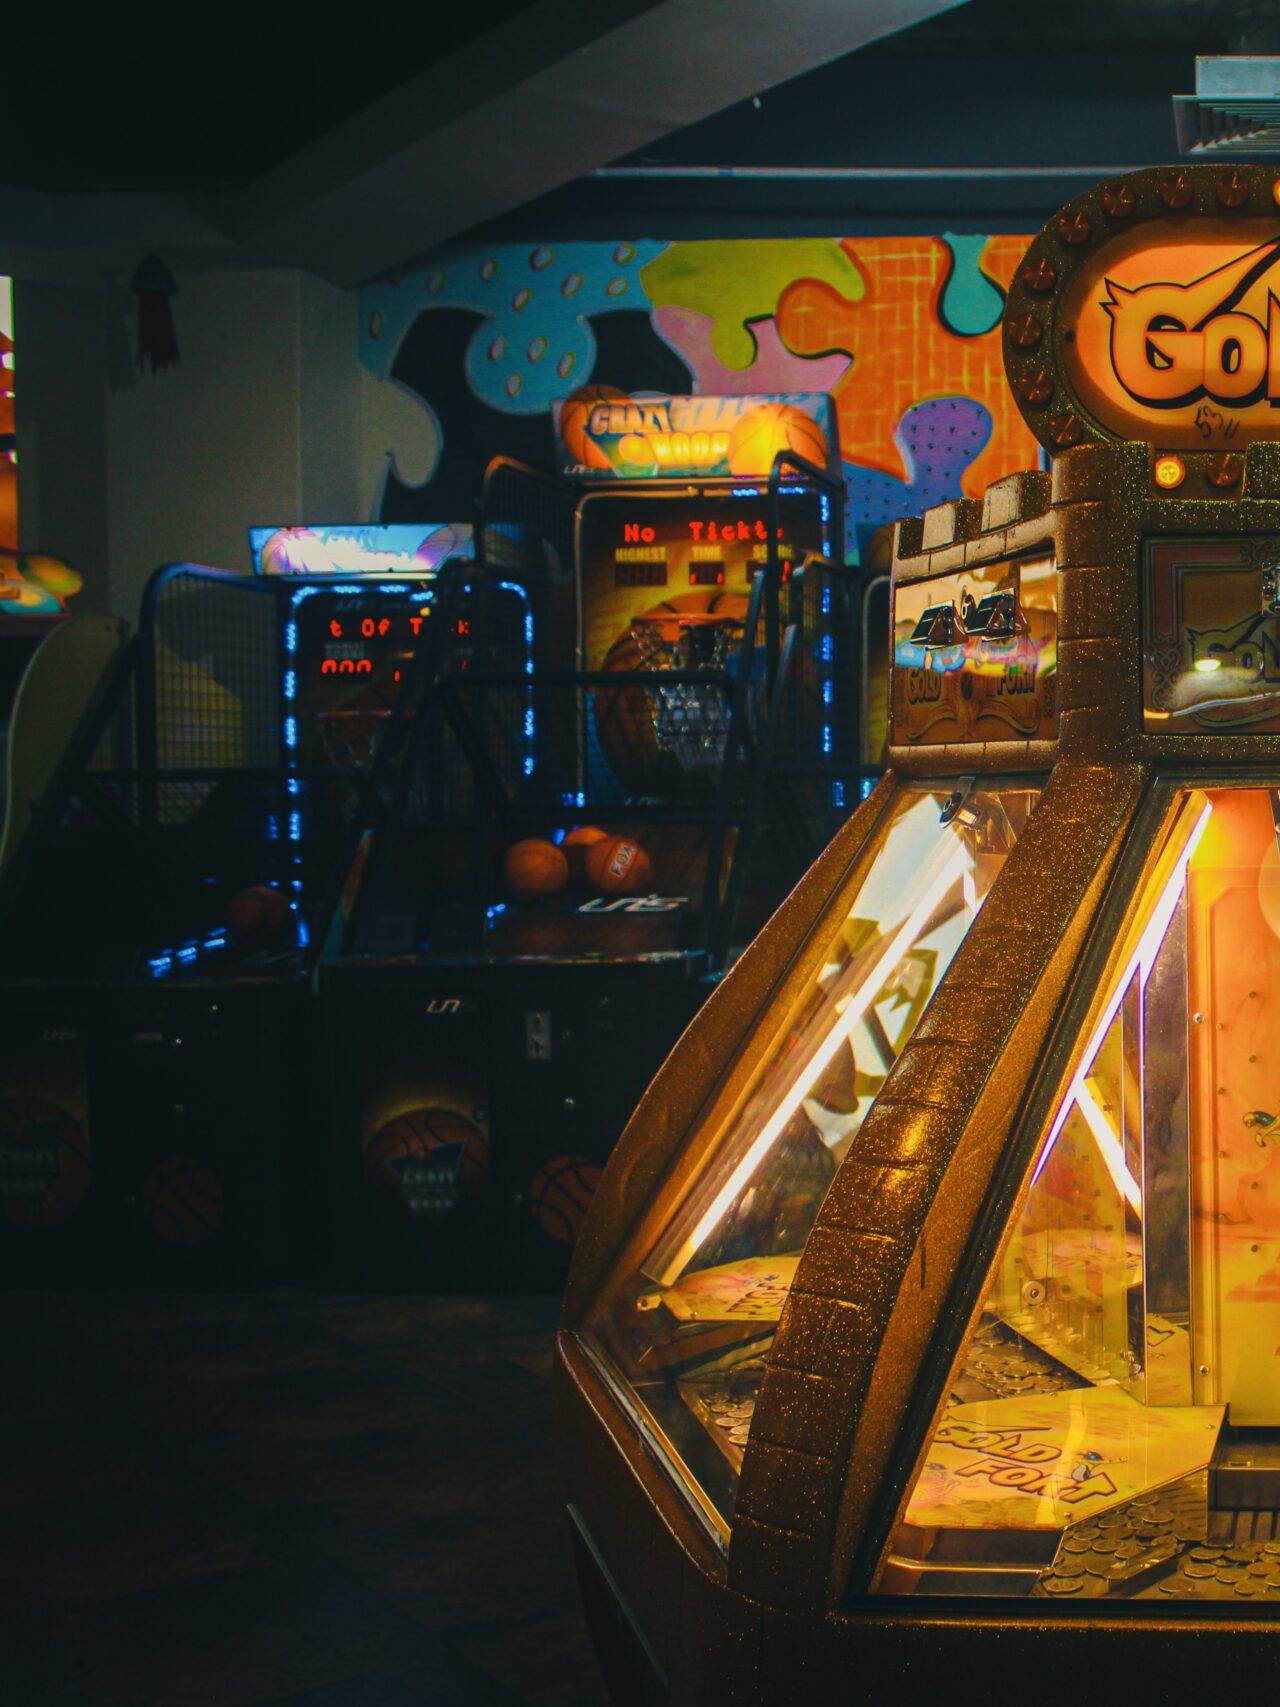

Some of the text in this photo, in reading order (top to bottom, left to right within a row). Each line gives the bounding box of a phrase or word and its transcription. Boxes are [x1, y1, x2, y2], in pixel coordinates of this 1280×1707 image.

[590, 403, 673, 436] CRAZY
[624, 523, 655, 542] No
[908, 667, 943, 705] GOLD
[933, 1416, 1064, 1463] GOLD
[955, 1457, 1118, 1504] FORT
